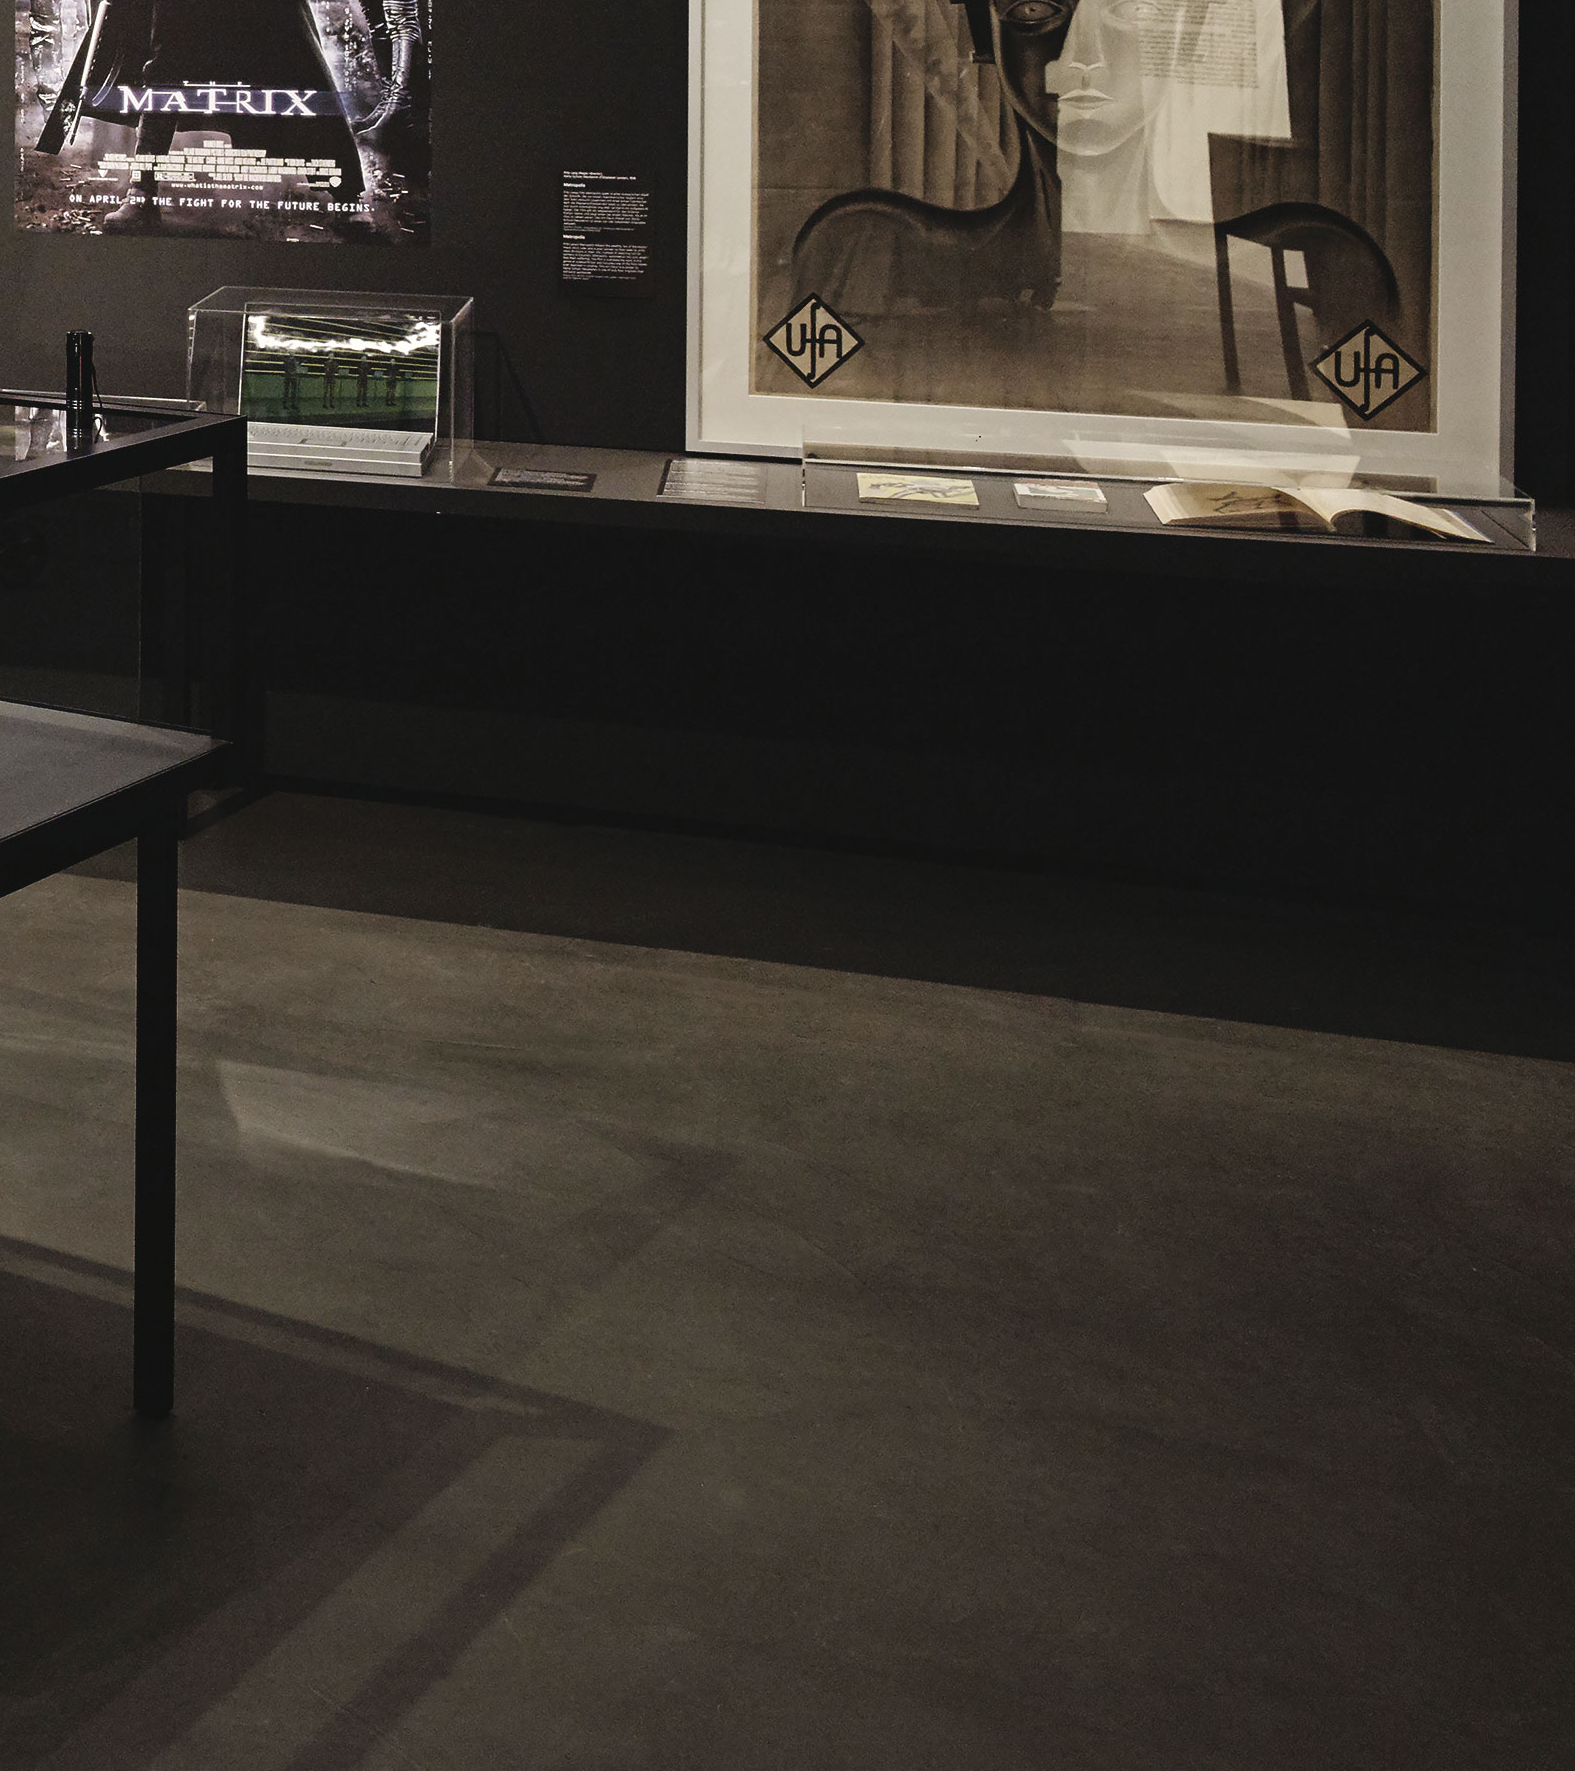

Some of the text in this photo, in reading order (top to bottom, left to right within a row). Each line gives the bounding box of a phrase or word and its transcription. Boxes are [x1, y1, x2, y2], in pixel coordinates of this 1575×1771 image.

[117, 85, 317, 116] MATRIX
[69, 194, 85, 203] ON
[89, 195, 123, 205] APRIL
[152, 197, 172, 207] THE
[179, 198, 214, 208] FIGHT
[221, 199, 242, 209] FOR
[250, 200, 270, 210] THE
[277, 201, 321, 211] FUTURE
[327, 202, 376, 213] BEGINS.
